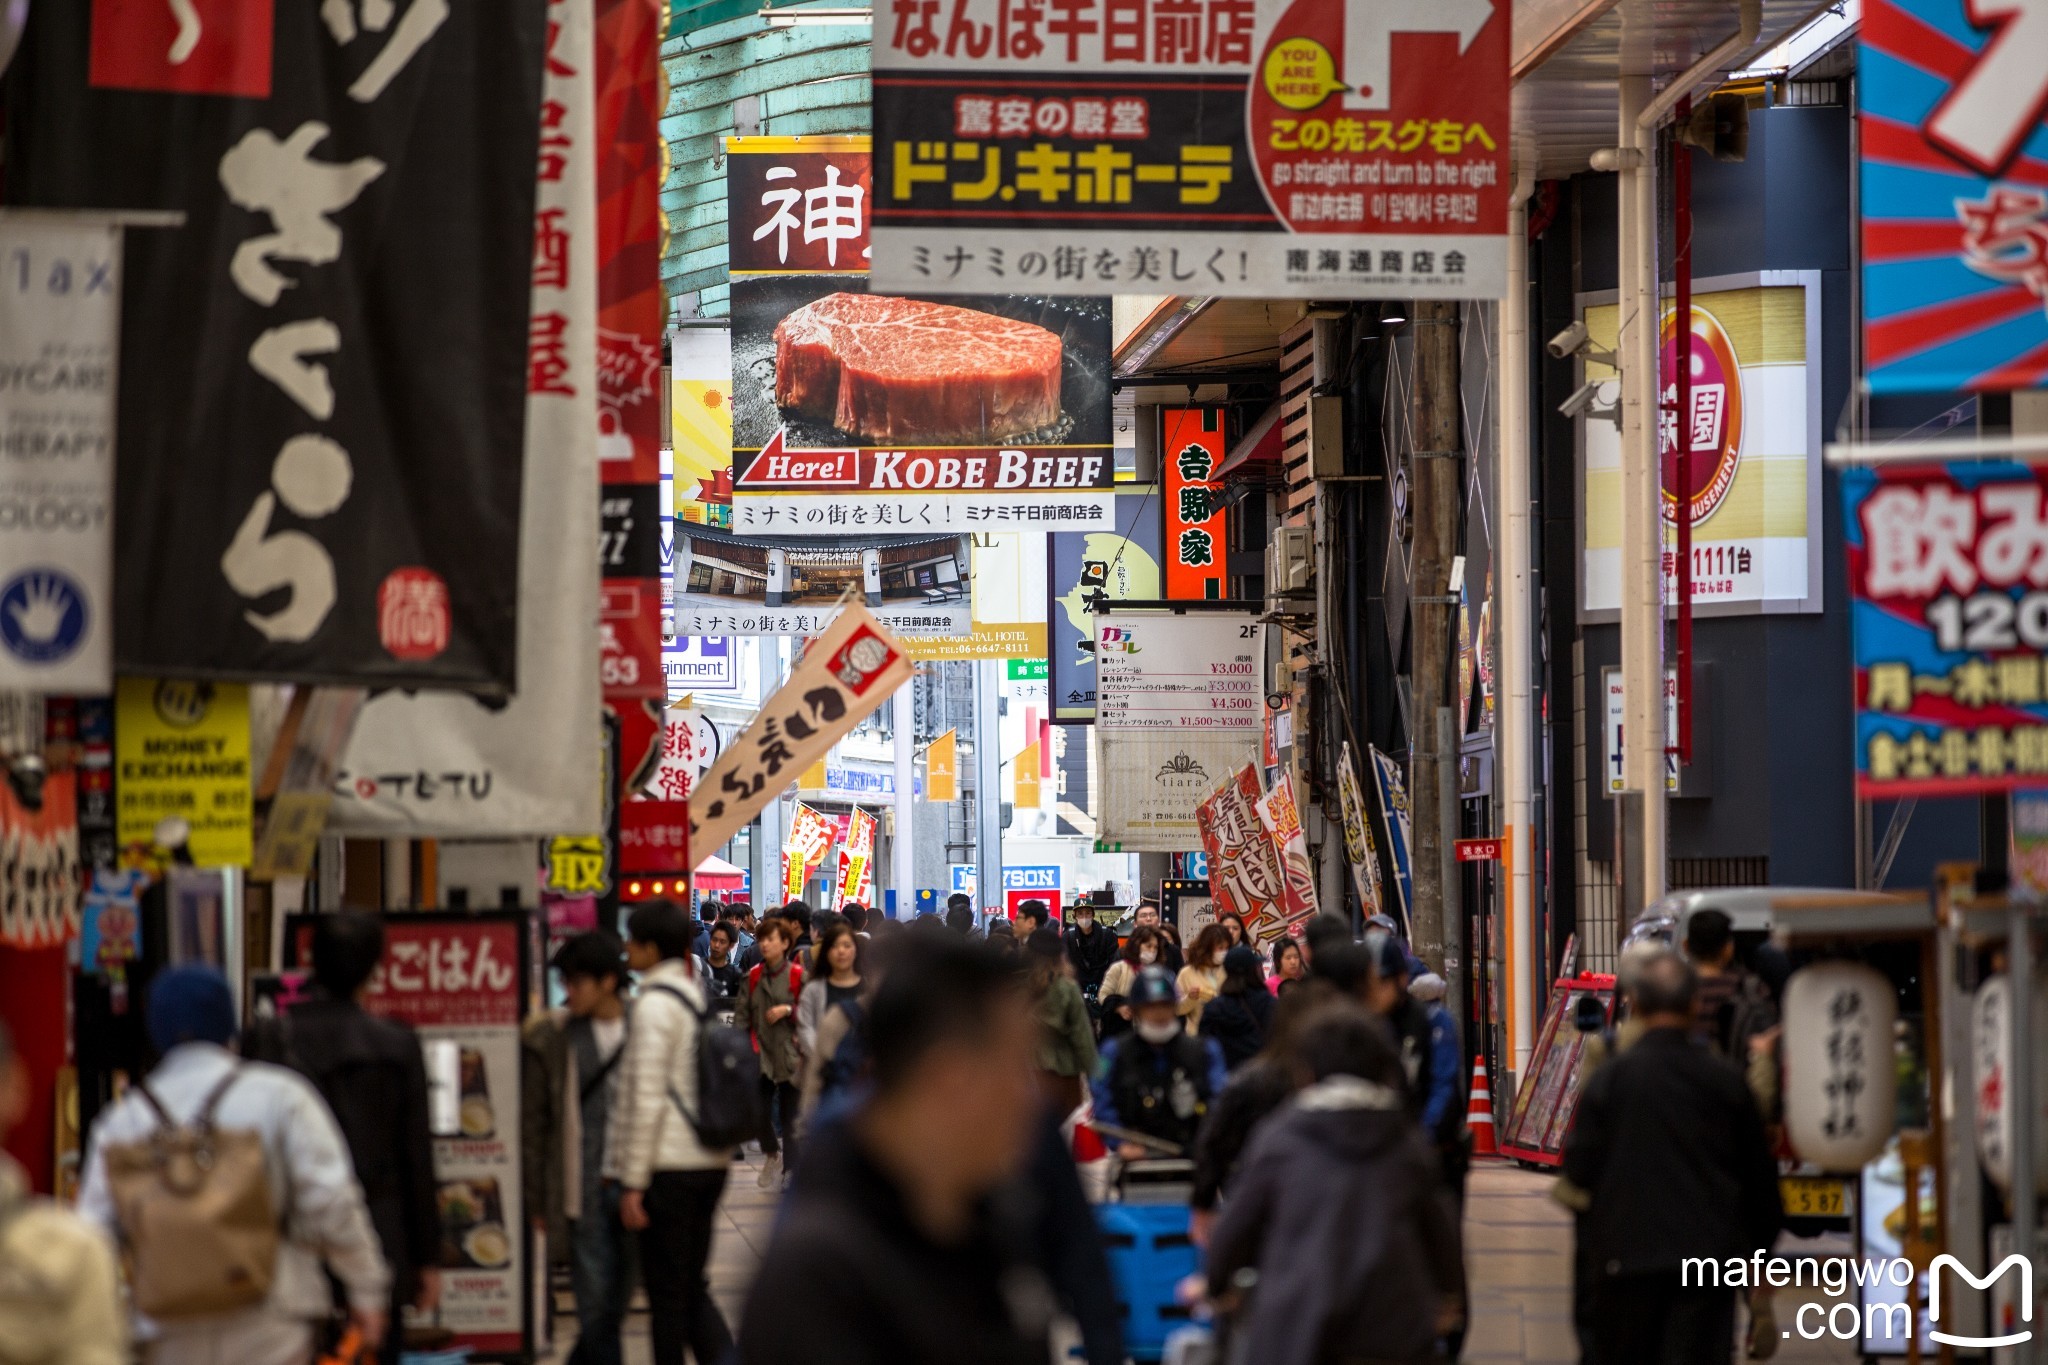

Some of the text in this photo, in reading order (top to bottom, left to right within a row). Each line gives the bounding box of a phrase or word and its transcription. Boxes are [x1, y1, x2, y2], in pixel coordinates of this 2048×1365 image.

[891, 0, 1254, 64] なんば千日前店
[1281, 49, 1317, 61] YOU
[1282, 66, 1315, 78] ARE
[1275, 83, 1321, 95] HERE
[957, 98, 1147, 134] 驚安の殿堂
[1269, 118, 1497, 153] この先スグ右へ
[1272, 159, 1497, 188] go straight and turn to the right
[753, 165, 871, 267] 神
[1286, 249, 1467, 273] 南海通商店会
[767, 449, 1104, 489] Here! KOBE BEEF
[1690, 444, 1738, 519] MUSEMENT
[966, 503, 1104, 522] ミナミ千日前商店会
[1176, 442, 1214, 568] 吉野家
[1694, 546, 1752, 577] 1111台
[996, 631, 1028, 641] HOTEL
[1239, 625, 1258, 639] 2F
[1211, 663, 1253, 675] ¥3,000
[144, 738, 227, 755] MONEY
[122, 761, 246, 780] EXCHANGE
[1162, 777, 1203, 787] tiara
[1462, 845, 1495, 855] 送水口
[958, 869, 1055, 888] LSON
